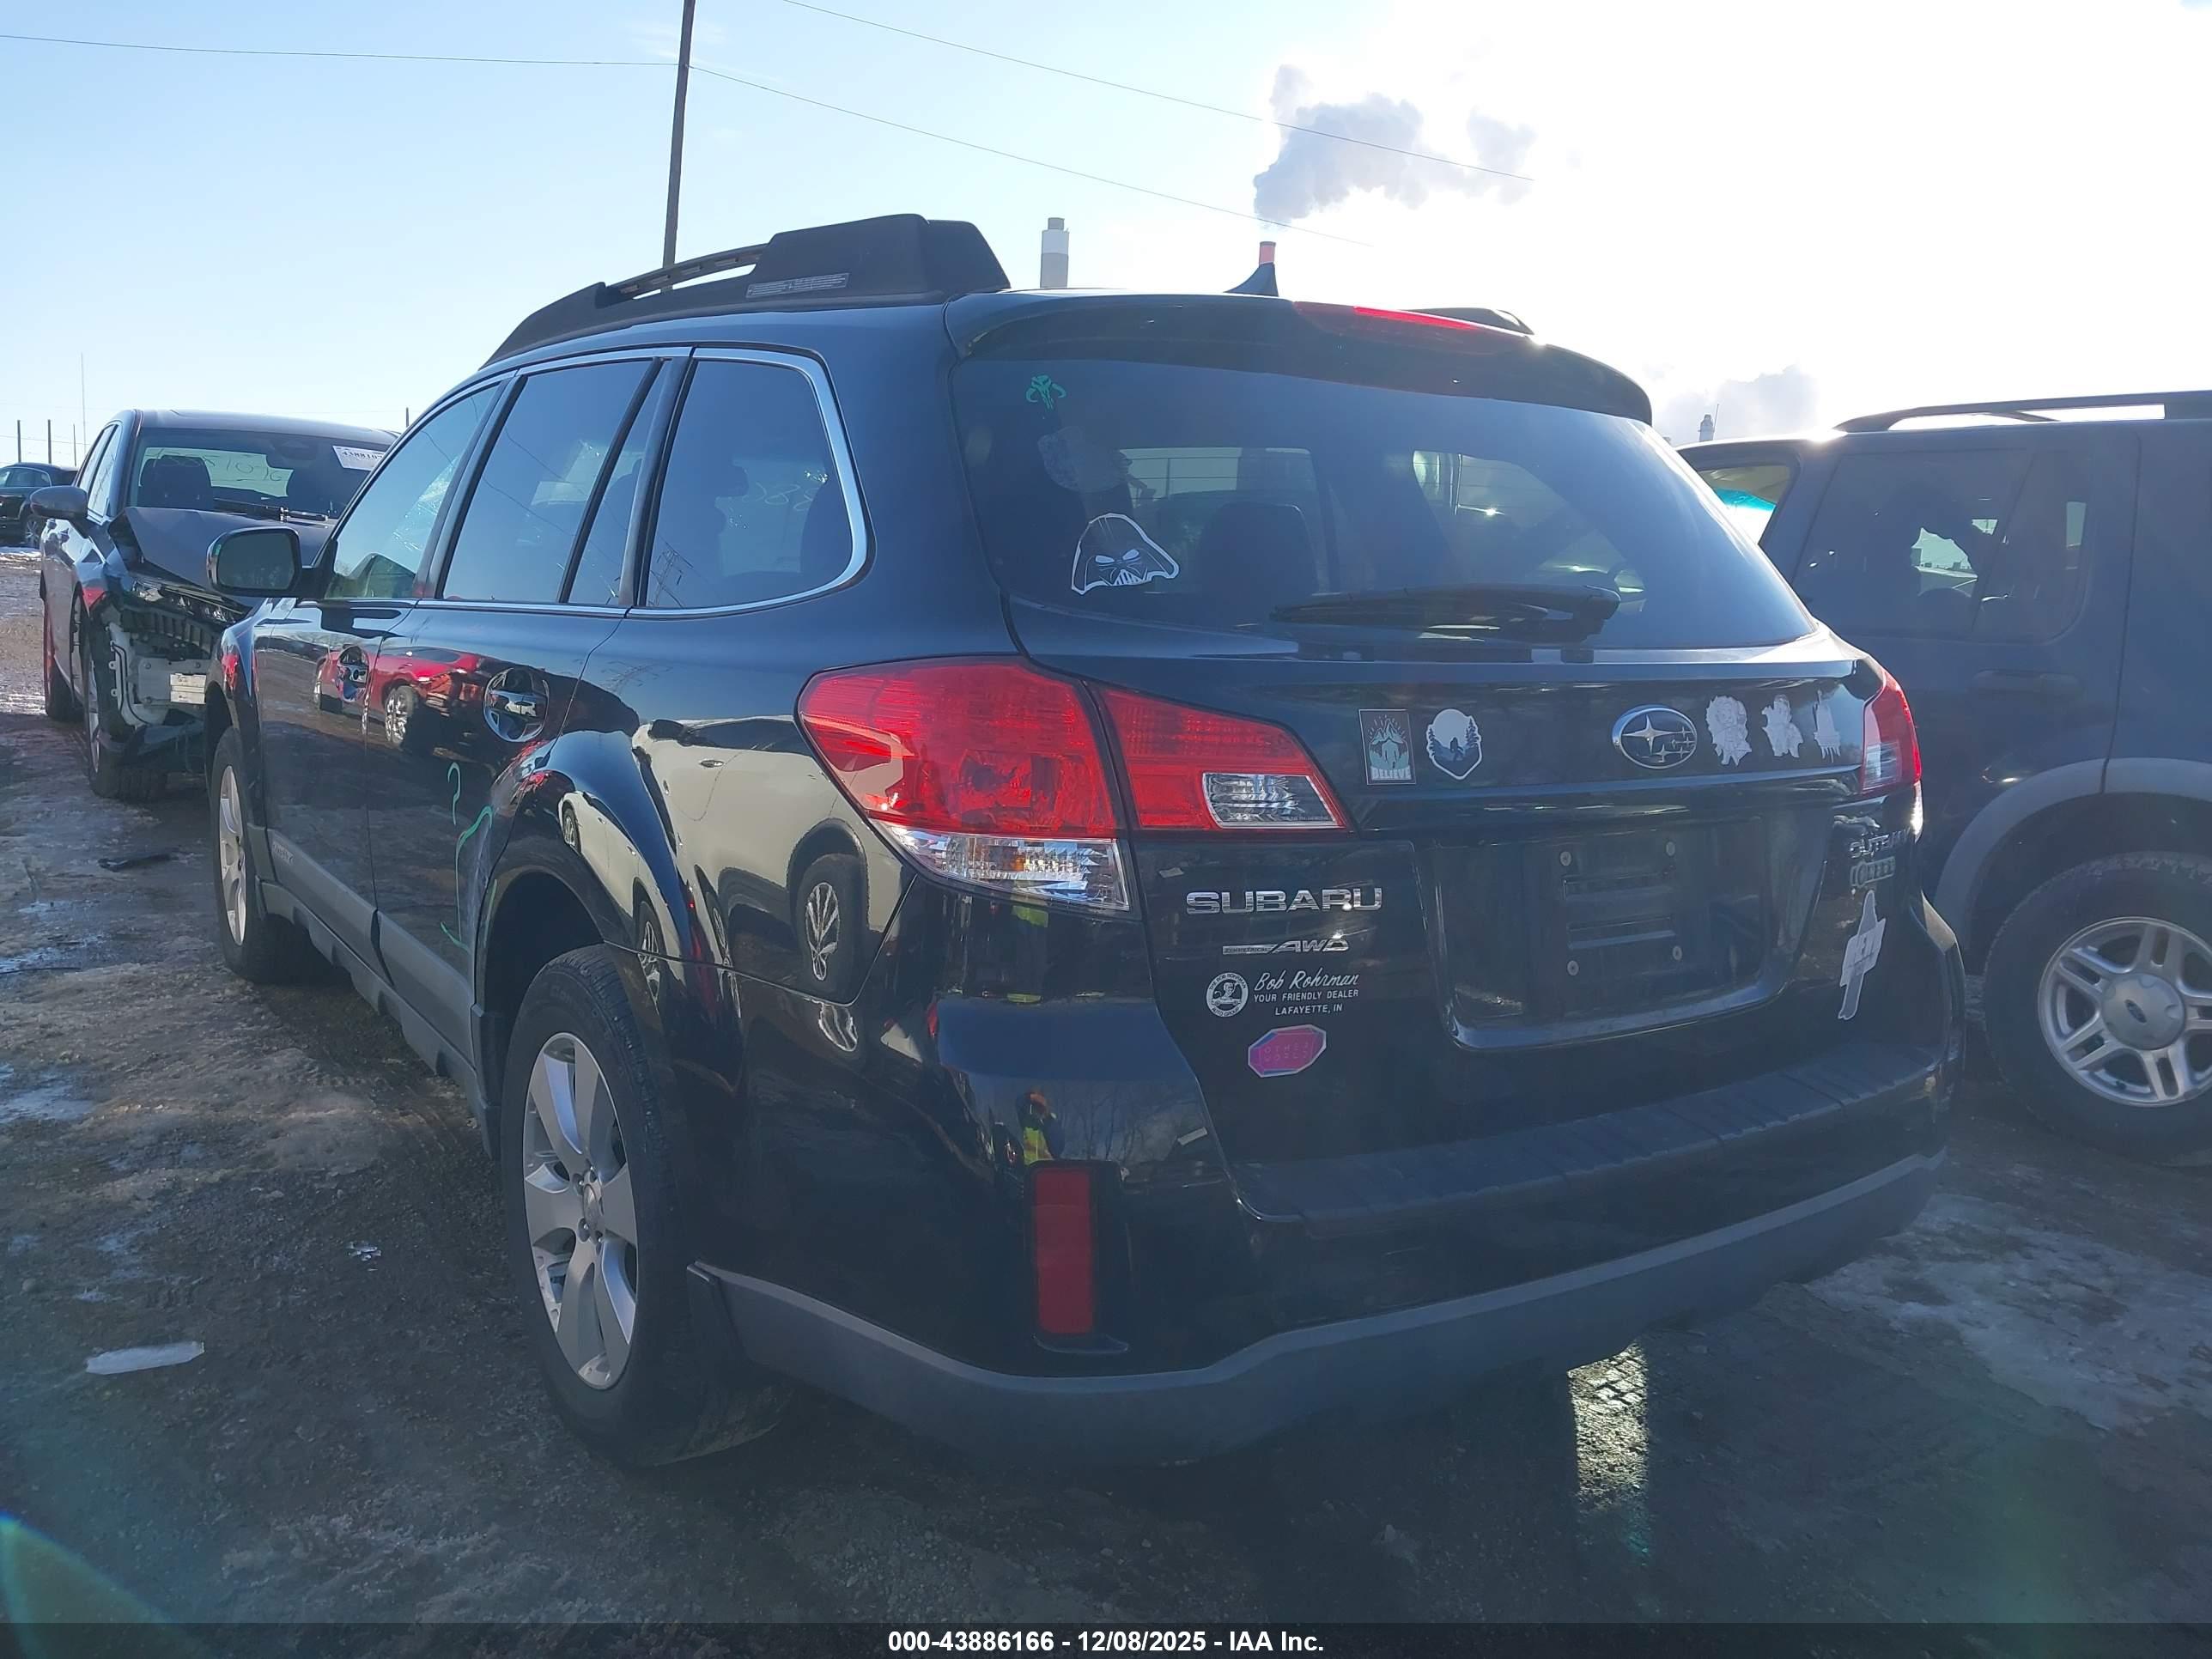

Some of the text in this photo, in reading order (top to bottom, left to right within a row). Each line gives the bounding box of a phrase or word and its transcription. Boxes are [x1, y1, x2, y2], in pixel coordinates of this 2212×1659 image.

[1370, 766, 1412, 780] BELIEVE
[1186, 888, 1382, 915] SUBARU
[1273, 939, 1350, 953] AWD
[1254, 967, 1360, 991] Bob Rohrman
[1254, 989, 1359, 1003] YOUR FRIENDLY DEALER
[1275, 1004, 1343, 1016] LAFAYETTE, IN
